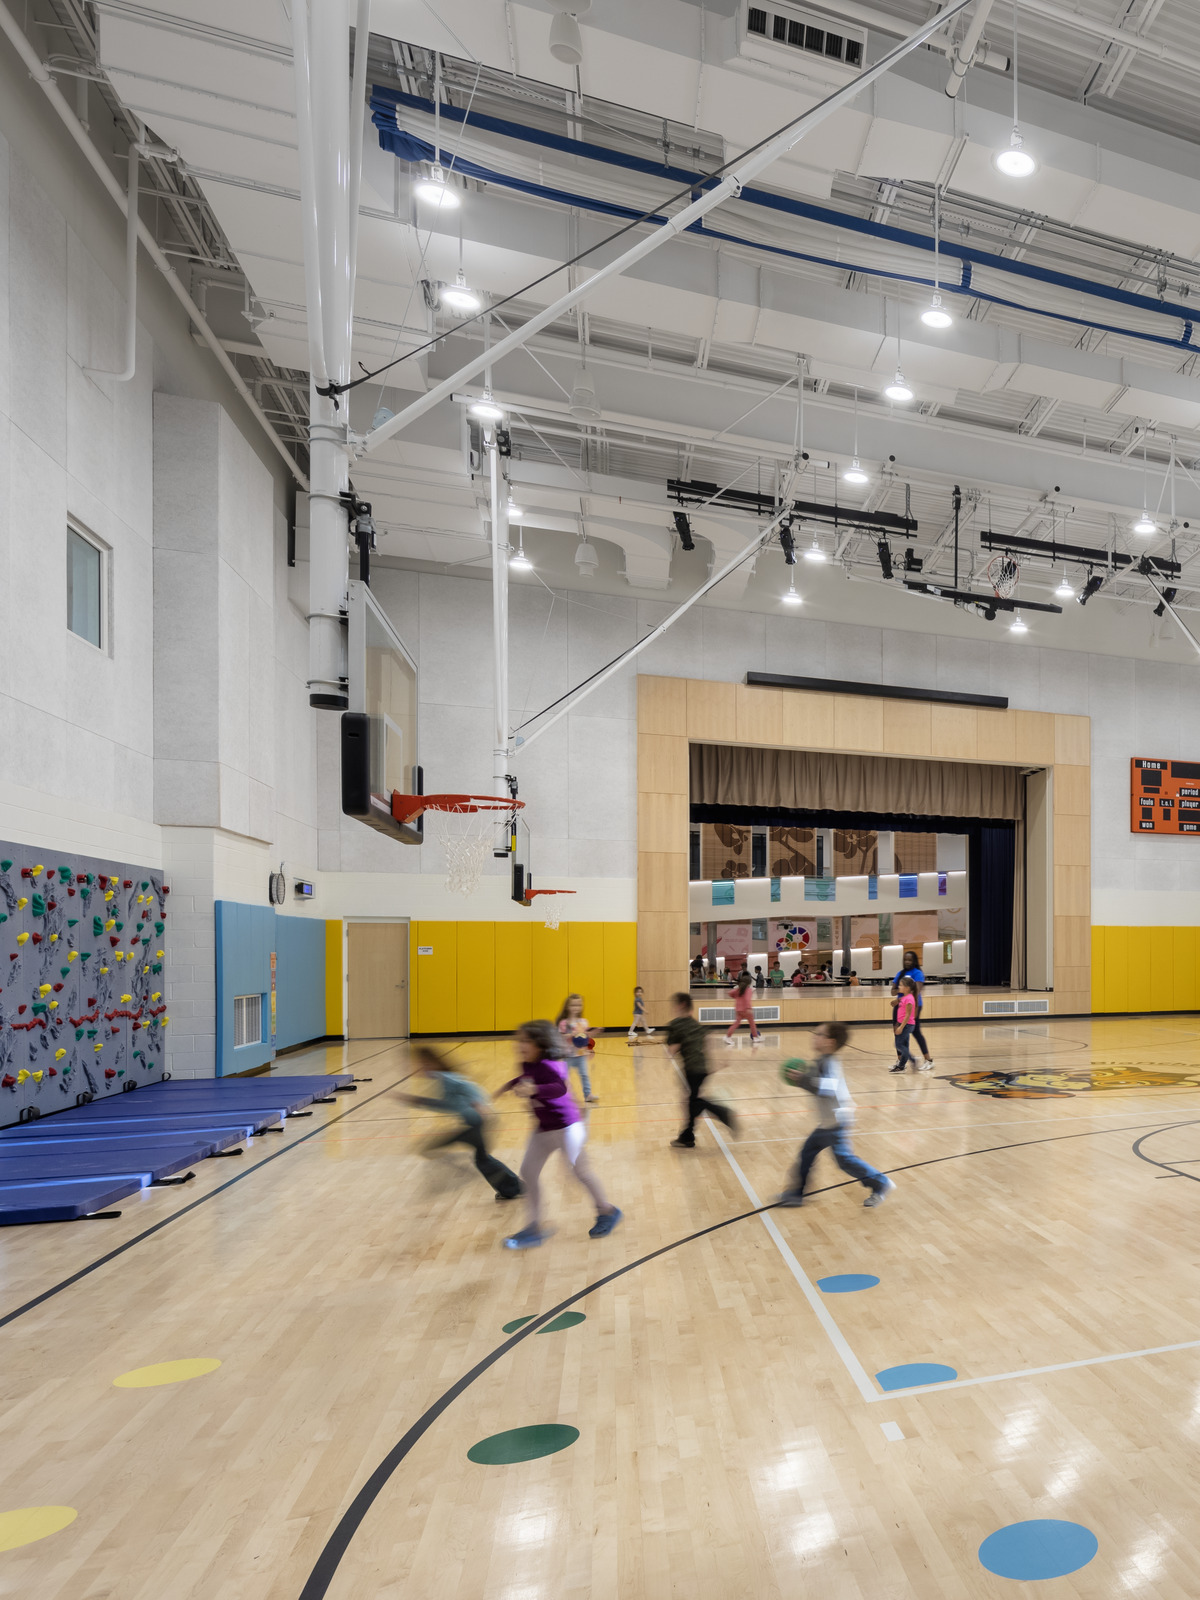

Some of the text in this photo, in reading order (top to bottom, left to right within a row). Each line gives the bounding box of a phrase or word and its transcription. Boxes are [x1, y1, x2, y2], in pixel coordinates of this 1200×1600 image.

[1142, 760, 1161, 769] Home
[1181, 788, 1199, 797] period
[1140, 797, 1154, 806] fouls
[1181, 800, 1199, 809] player
